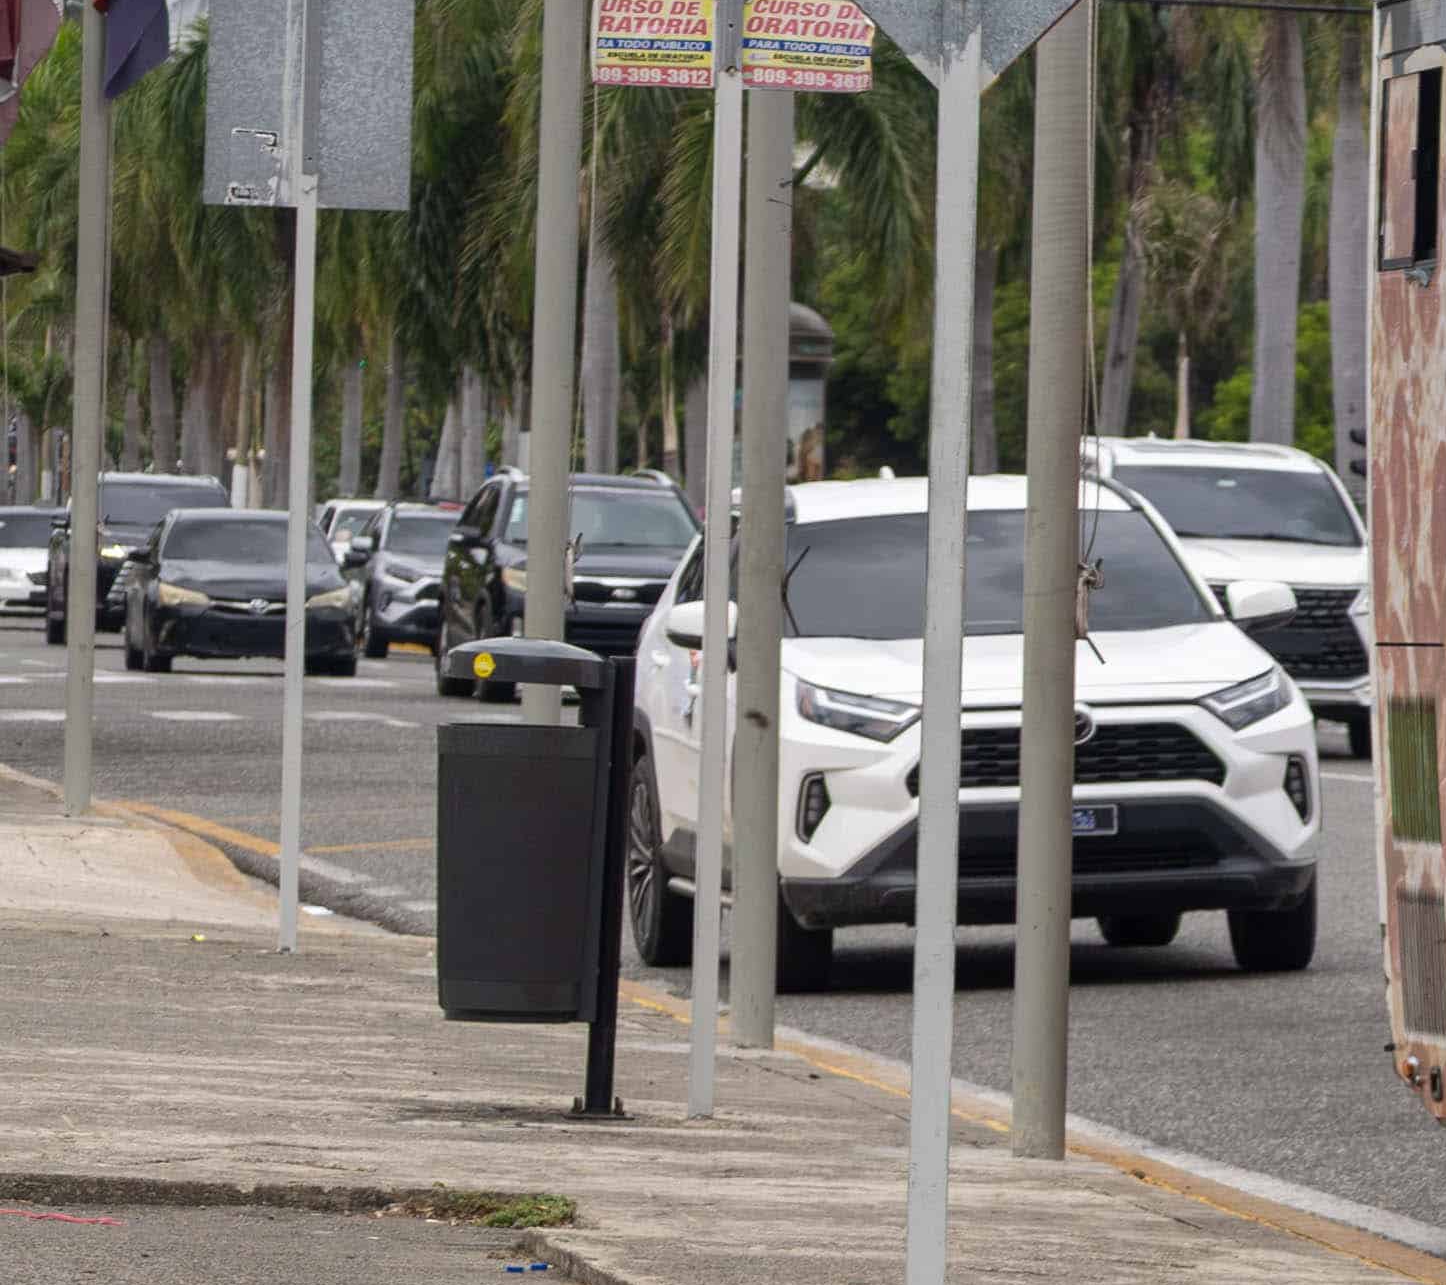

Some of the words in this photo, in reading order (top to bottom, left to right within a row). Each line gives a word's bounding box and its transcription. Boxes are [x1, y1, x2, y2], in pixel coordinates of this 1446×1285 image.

[669, 0, 701, 16] DE
[618, 39, 651, 49] TODO
[748, 39, 780, 50] PARA
[783, 41, 817, 52] TODO
[594, 66, 709, 85] 09-399-3812
